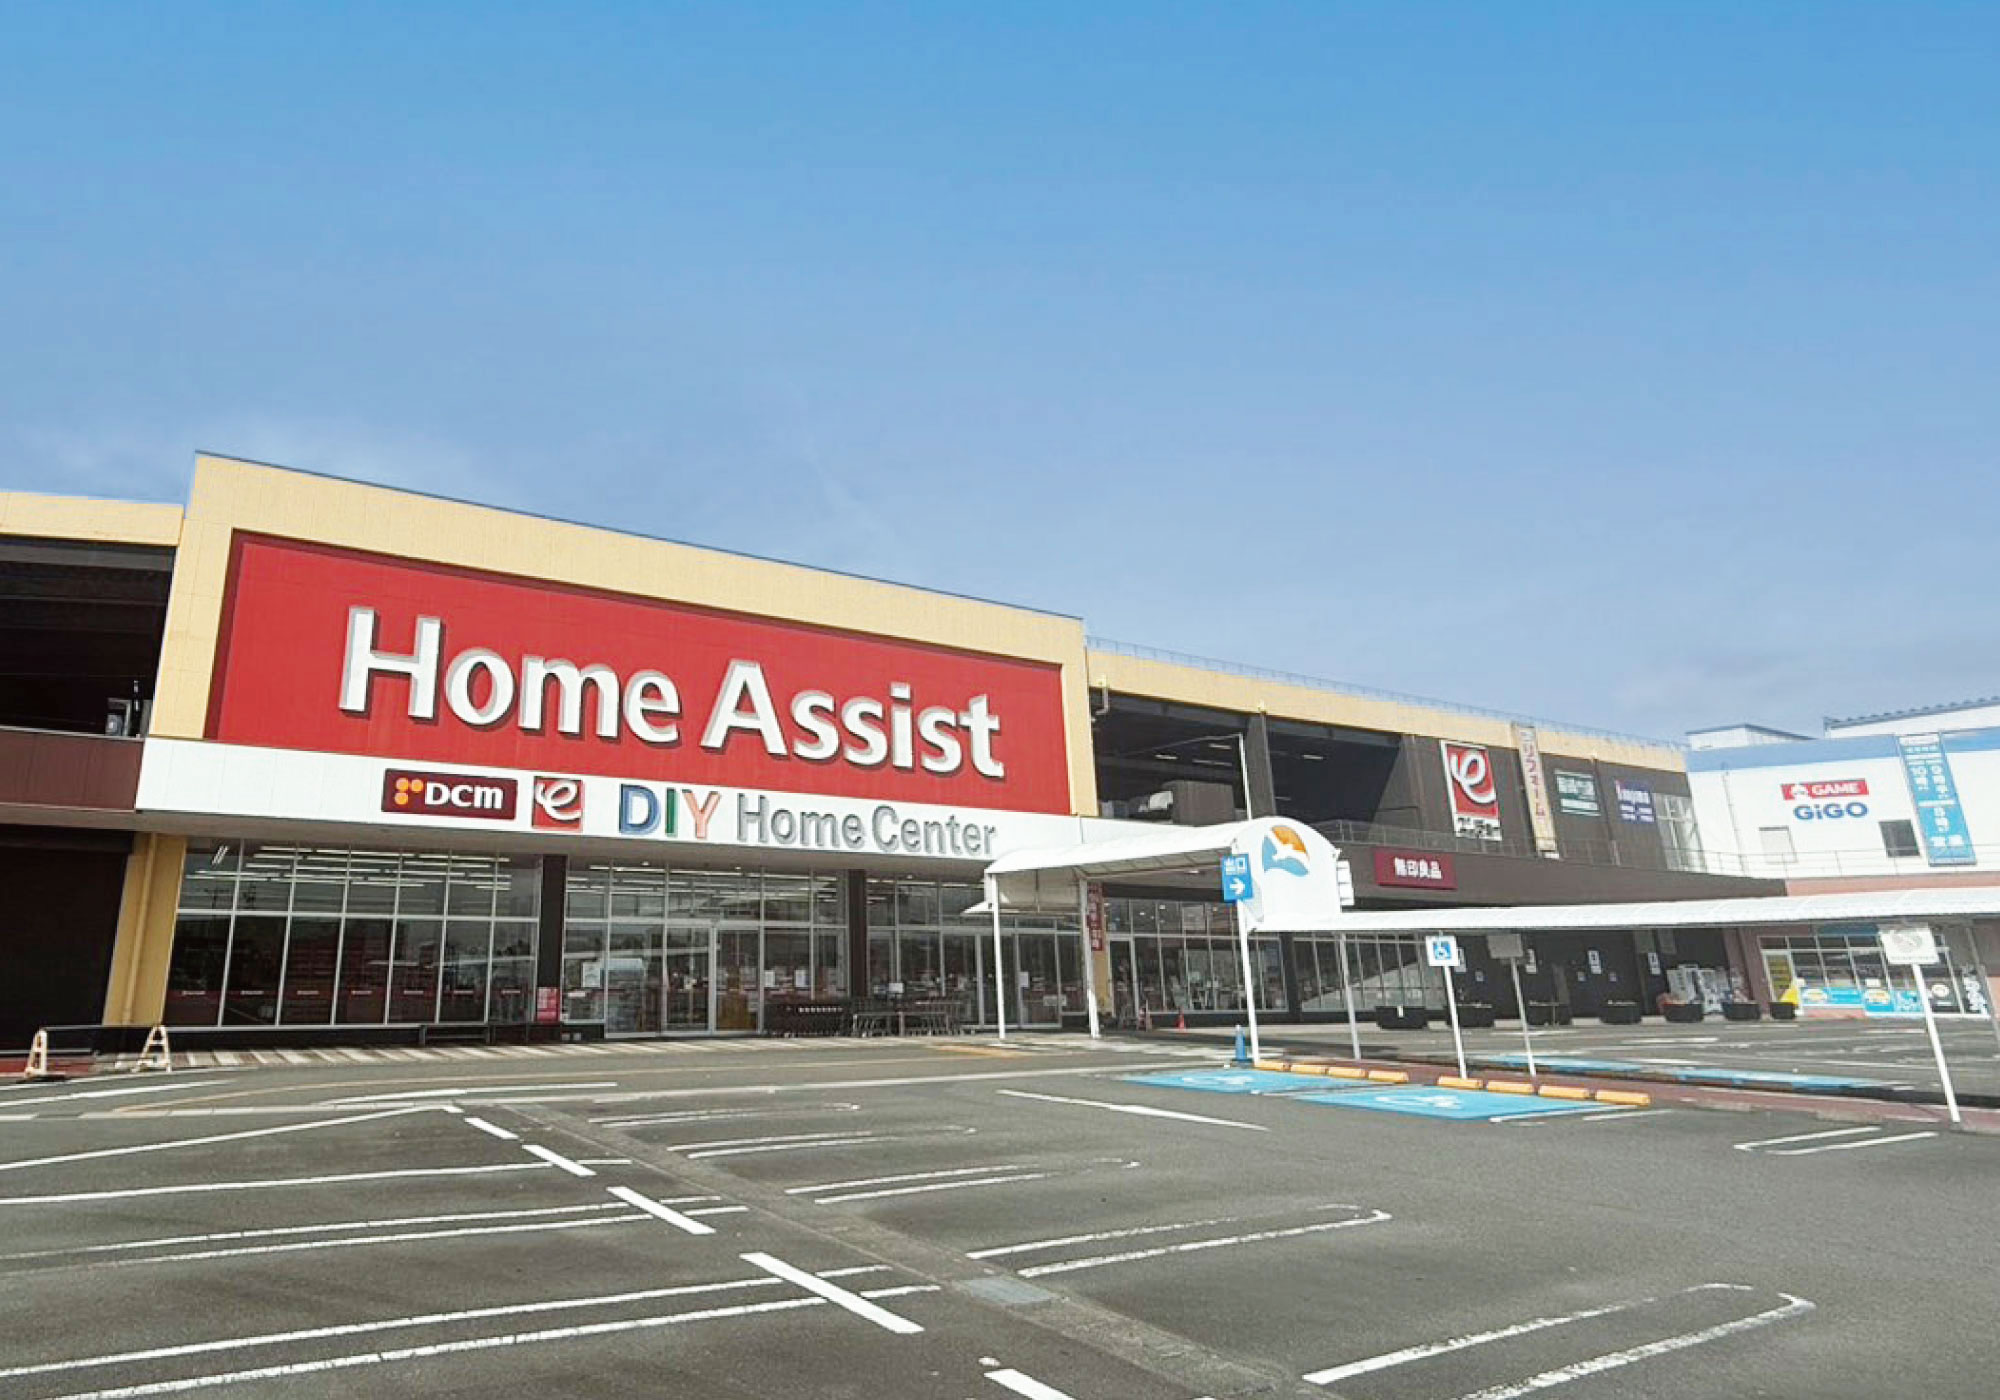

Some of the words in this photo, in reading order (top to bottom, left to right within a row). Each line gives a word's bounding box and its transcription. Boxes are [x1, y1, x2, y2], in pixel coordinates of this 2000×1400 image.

[339, 605, 681, 744] Home
[700, 659, 1005, 778] Assist
[1793, 802, 1869, 820] GiGO
[1811, 783, 1859, 796] GAME
[618, 783, 721, 839] DIY
[737, 793, 864, 846] Home
[871, 805, 997, 857] Center
